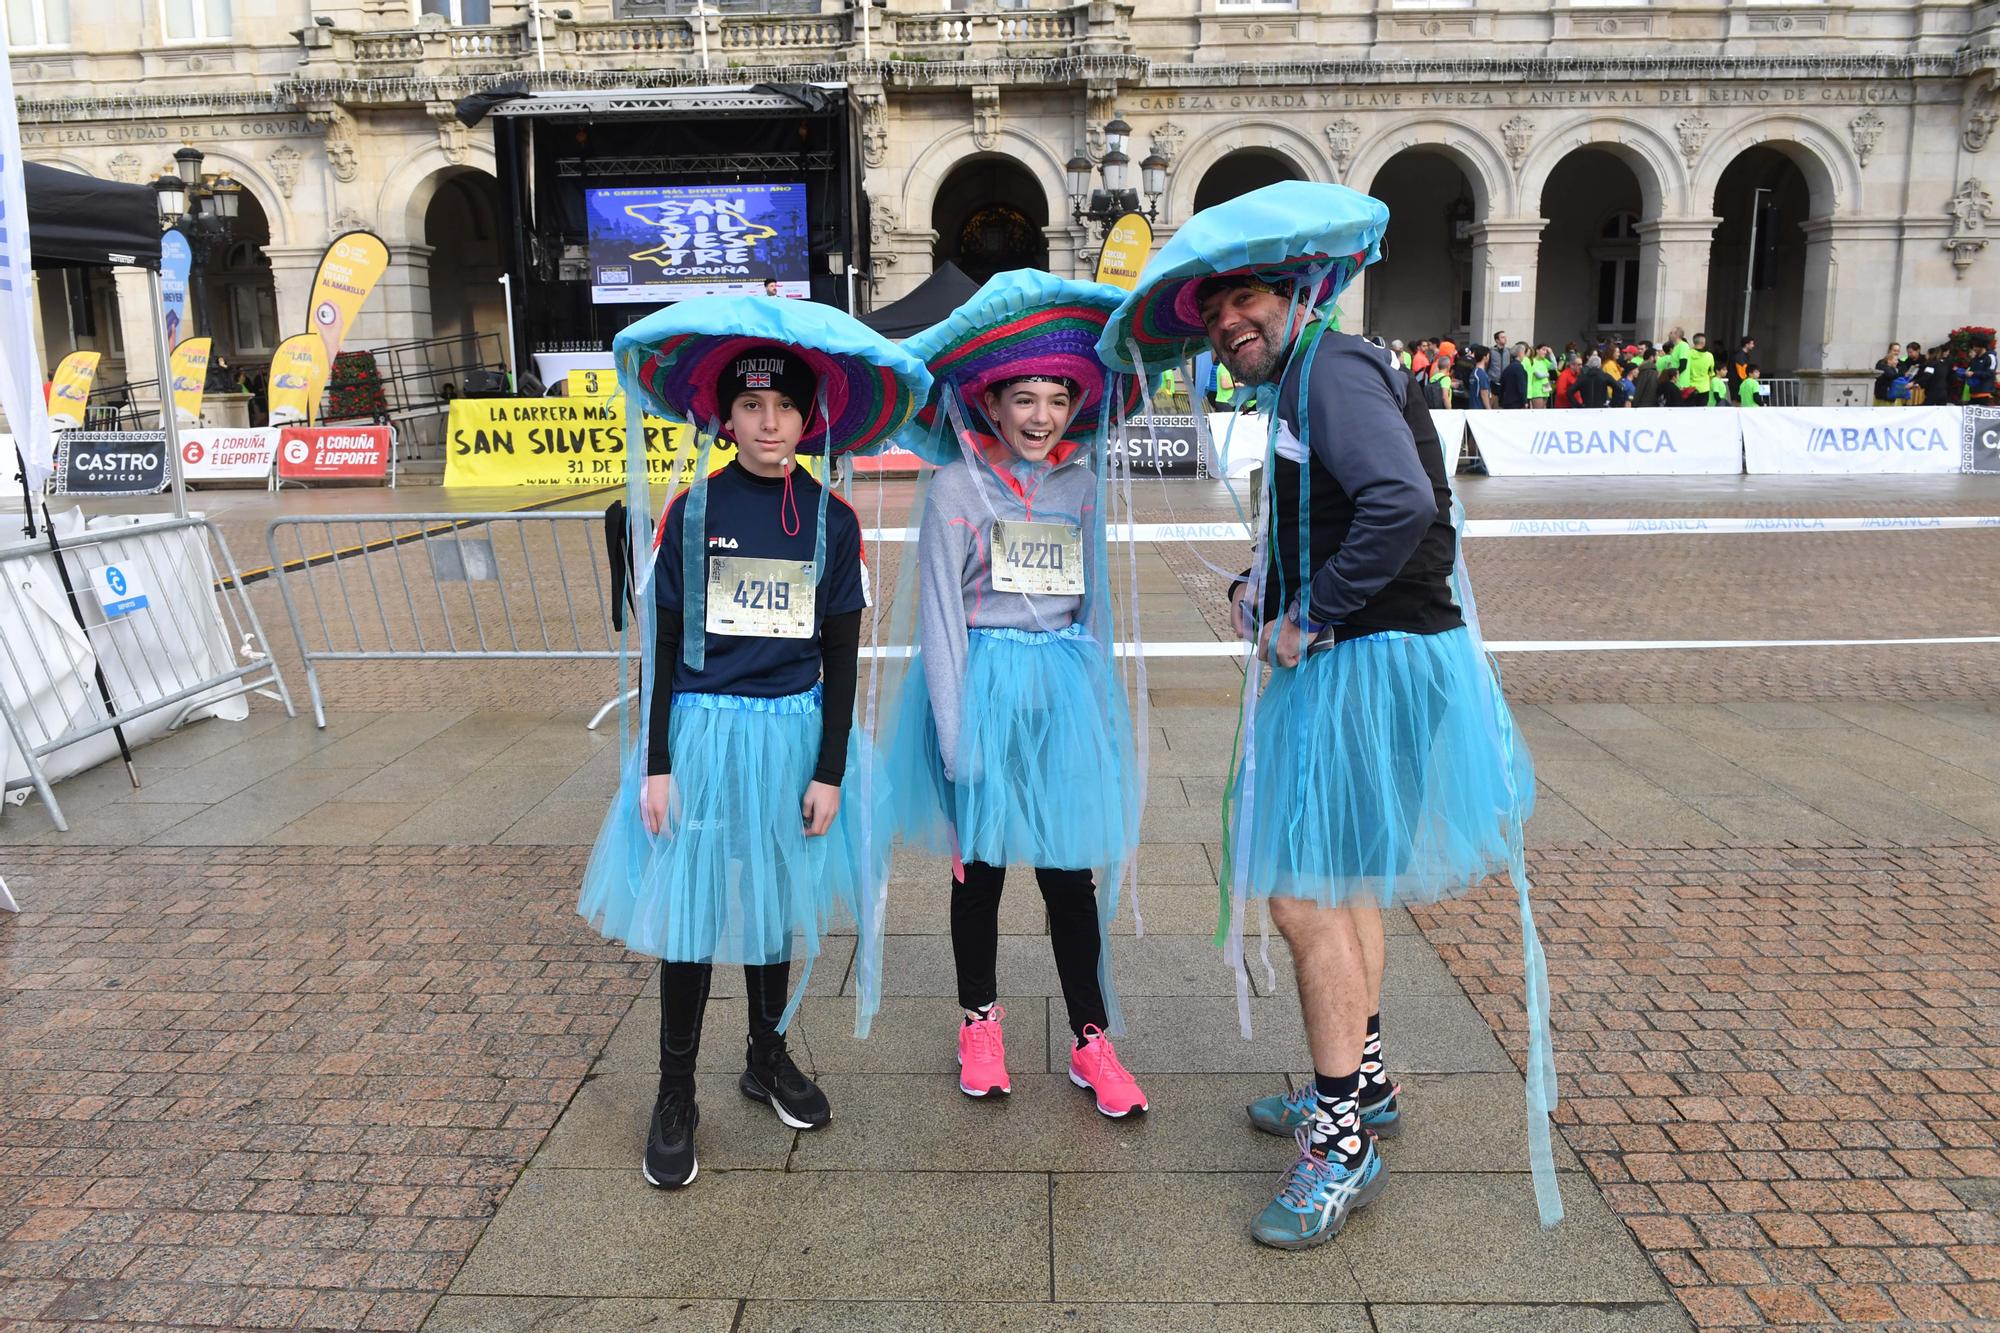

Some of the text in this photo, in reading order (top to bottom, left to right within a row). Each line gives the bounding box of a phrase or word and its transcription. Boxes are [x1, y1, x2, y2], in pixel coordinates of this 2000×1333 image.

[1140, 87, 1899, 110] CABEZA GVARDA Y LLAVE FVERZA Y ANTEMVRAL DEL REINO DE GALICIA
[57, 129, 96, 142] LEAL
[106, 127, 168, 140] CIVDAD
[180, 126, 201, 137] DE
[211, 124, 230, 136] LA
[240, 119, 312, 135] CORVÑA
[659, 198, 746, 216] SAN
[659, 215, 747, 233] SIL
[660, 231, 749, 249] VES
[662, 248, 749, 266] TRE
[662, 264, 749, 276] CORUÑA
[1110, 268, 1137, 278] AMARILLO
[736, 358, 785, 377] LONDON
[585, 372, 598, 393] 3
[490, 403, 617, 421] LA CARRERA MÁS
[211, 434, 266, 450] A CORUÑA
[316, 433, 375, 449] A CORUÑA
[454, 428, 514, 455] SAN
[528, 427, 678, 455] SILVESRE
[75, 453, 158, 471] CASTRO
[220, 452, 270, 465] DEPORTE
[315, 449, 380, 465] É DEPORTE
[568, 460, 584, 473] 31
[592, 459, 611, 473] DE
[89, 472, 143, 481] ÓPTICOS
[709, 537, 739, 549] FILA
[1007, 541, 1063, 569] 4220
[733, 580, 790, 611] 4219
